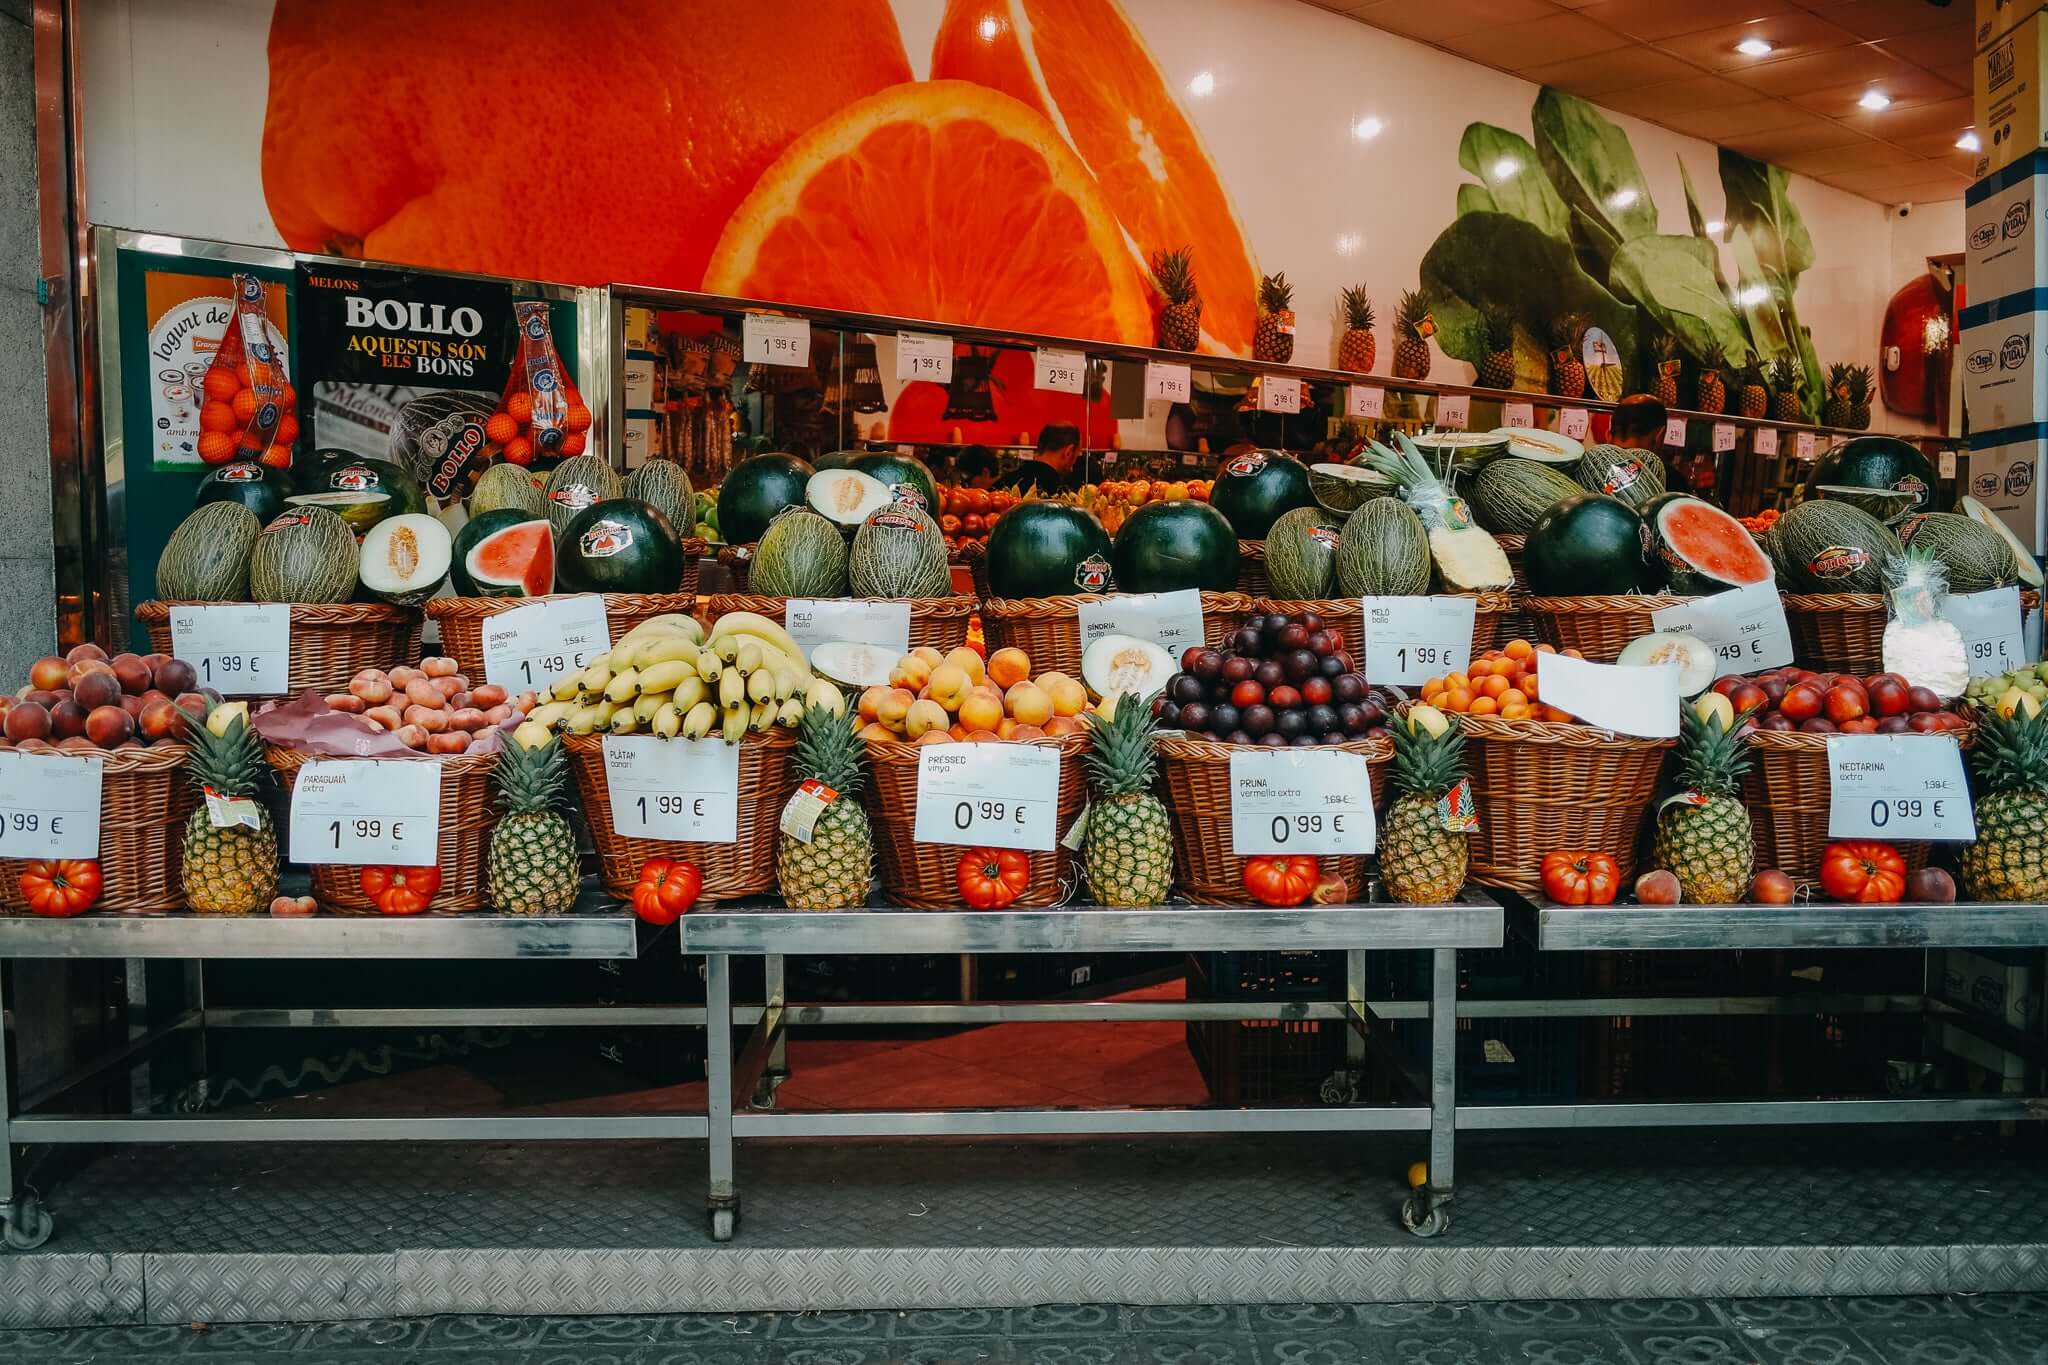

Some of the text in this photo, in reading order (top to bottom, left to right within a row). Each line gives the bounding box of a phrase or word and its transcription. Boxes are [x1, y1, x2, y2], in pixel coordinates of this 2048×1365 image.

[308, 275, 360, 291] MELONS
[205, 306, 230, 325] de
[345, 296, 484, 337] BOLLO
[348, 335, 487, 361] AQUESTS SÓN
[791, 340, 797, 351] €
[2003, 348, 2024, 362] VIDAL
[381, 354, 474, 377] ELS BONS
[936, 360, 942, 370] €
[432, 429, 481, 494] BOLLO
[793, 612, 813, 621] MELÓ
[1371, 608, 1390, 617] MELÓ
[177, 618, 194, 627] MELÓ
[793, 620, 811, 628] bollo
[1087, 622, 1116, 632] SÍNDRIA
[1372, 616, 1389, 624] bollo
[489, 630, 518, 642] SÍNDRIA
[1751, 640, 1763, 654] €
[1999, 641, 2007, 656] €
[1397, 648, 1453, 673] 1'99 €
[202, 656, 260, 682] 1'99 €
[520, 653, 585, 685] 1'49 €
[609, 749, 636, 760] PLÀTAN
[927, 764, 950, 773] vinya
[1839, 762, 1886, 772] NECTARINA
[1239, 778, 1268, 788] PRUNA
[1839, 772, 1863, 781] extra
[302, 784, 325, 793] extra
[1240, 787, 1301, 798] vermella extra
[636, 795, 705, 825] 1'99 €
[955, 801, 1027, 830] 0'99 €
[1870, 799, 1945, 827] 0'99 €
[51, 817, 64, 835] €
[1271, 815, 1345, 844] 0'99 €
[329, 820, 404, 849] 1'99 €
